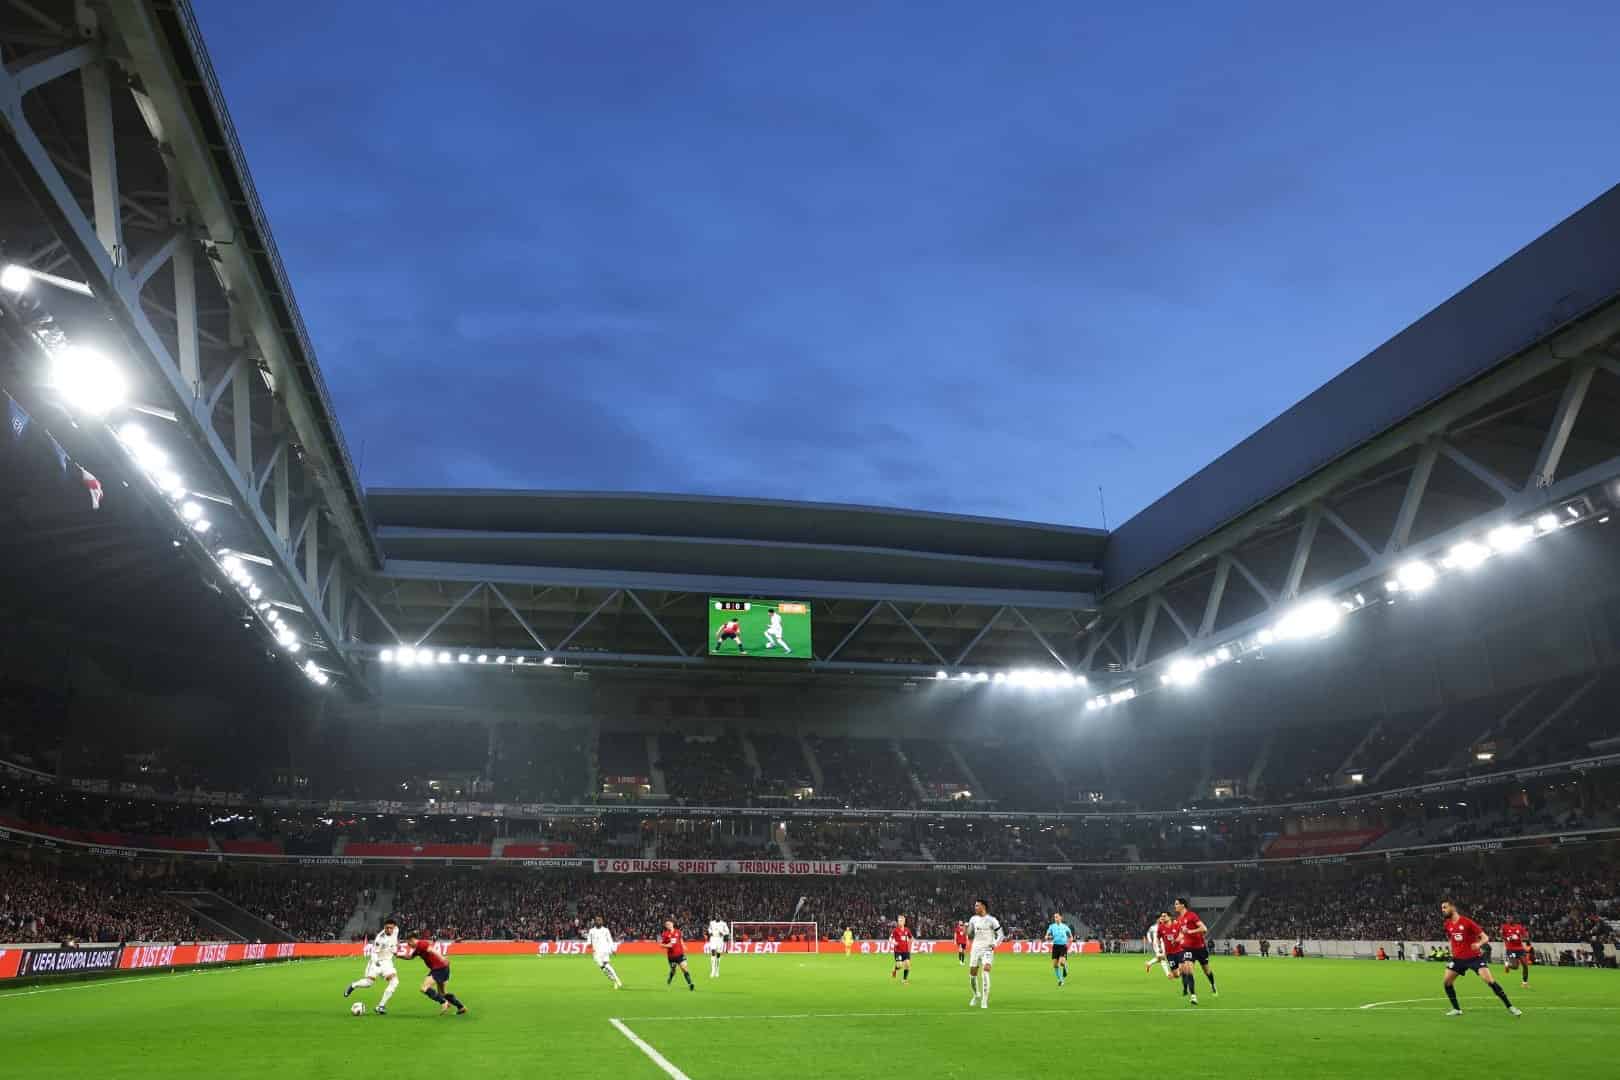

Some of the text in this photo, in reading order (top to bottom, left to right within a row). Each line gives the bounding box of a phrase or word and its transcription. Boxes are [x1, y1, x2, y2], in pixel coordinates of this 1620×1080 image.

[613, 860, 629, 872] GO
[678, 861, 717, 873] SPIRIT
[738, 862, 841, 875] TRIBUNE SUD LILLE
[554, 942, 588, 954] JUST
[755, 942, 781, 954] EAT
[911, 942, 937, 953] EAT
[32, 951, 117, 971] UEFA EUROPA LEAGUE
[139, 945, 177, 967] JUST EAT
